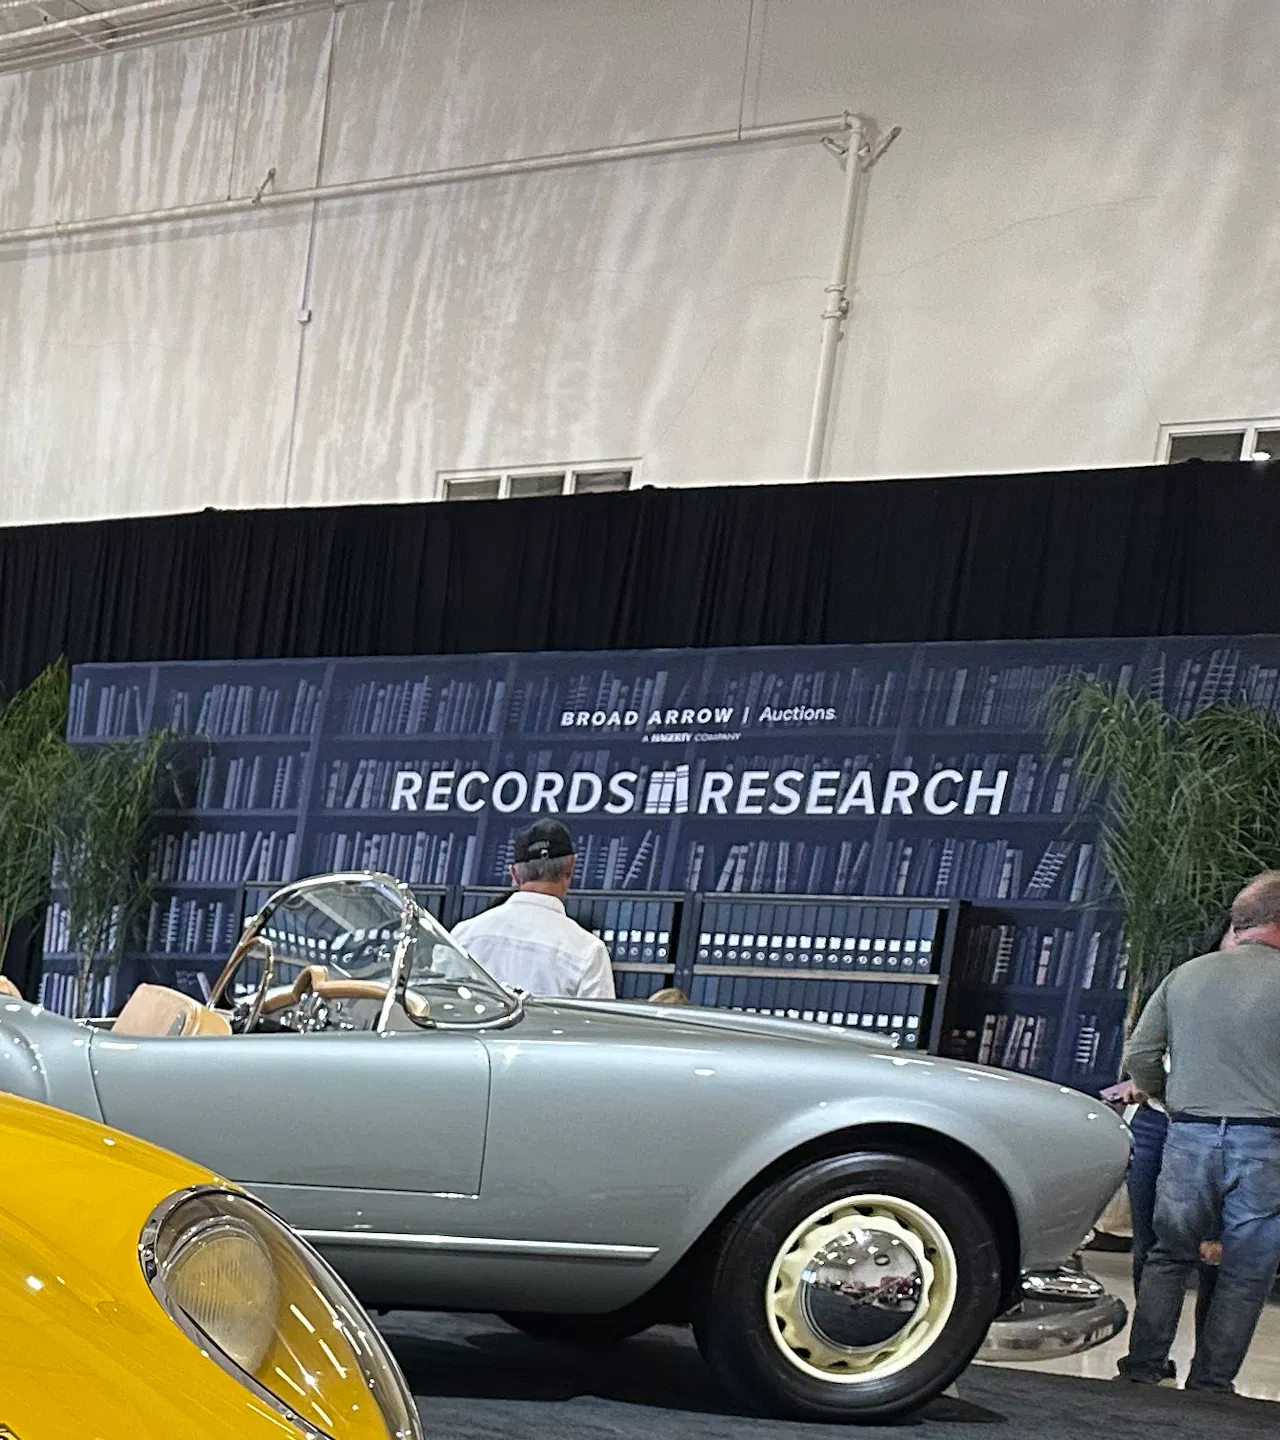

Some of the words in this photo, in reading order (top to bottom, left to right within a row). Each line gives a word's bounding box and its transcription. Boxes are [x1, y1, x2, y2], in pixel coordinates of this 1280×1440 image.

[560, 710, 639, 727] BROAD
[646, 707, 734, 725] ARROW
[759, 706, 836, 721] Auctions
[694, 732, 741, 741] COMPANY
[391, 771, 637, 814] RECORDS
[699, 769, 1009, 815] RESEARCH
